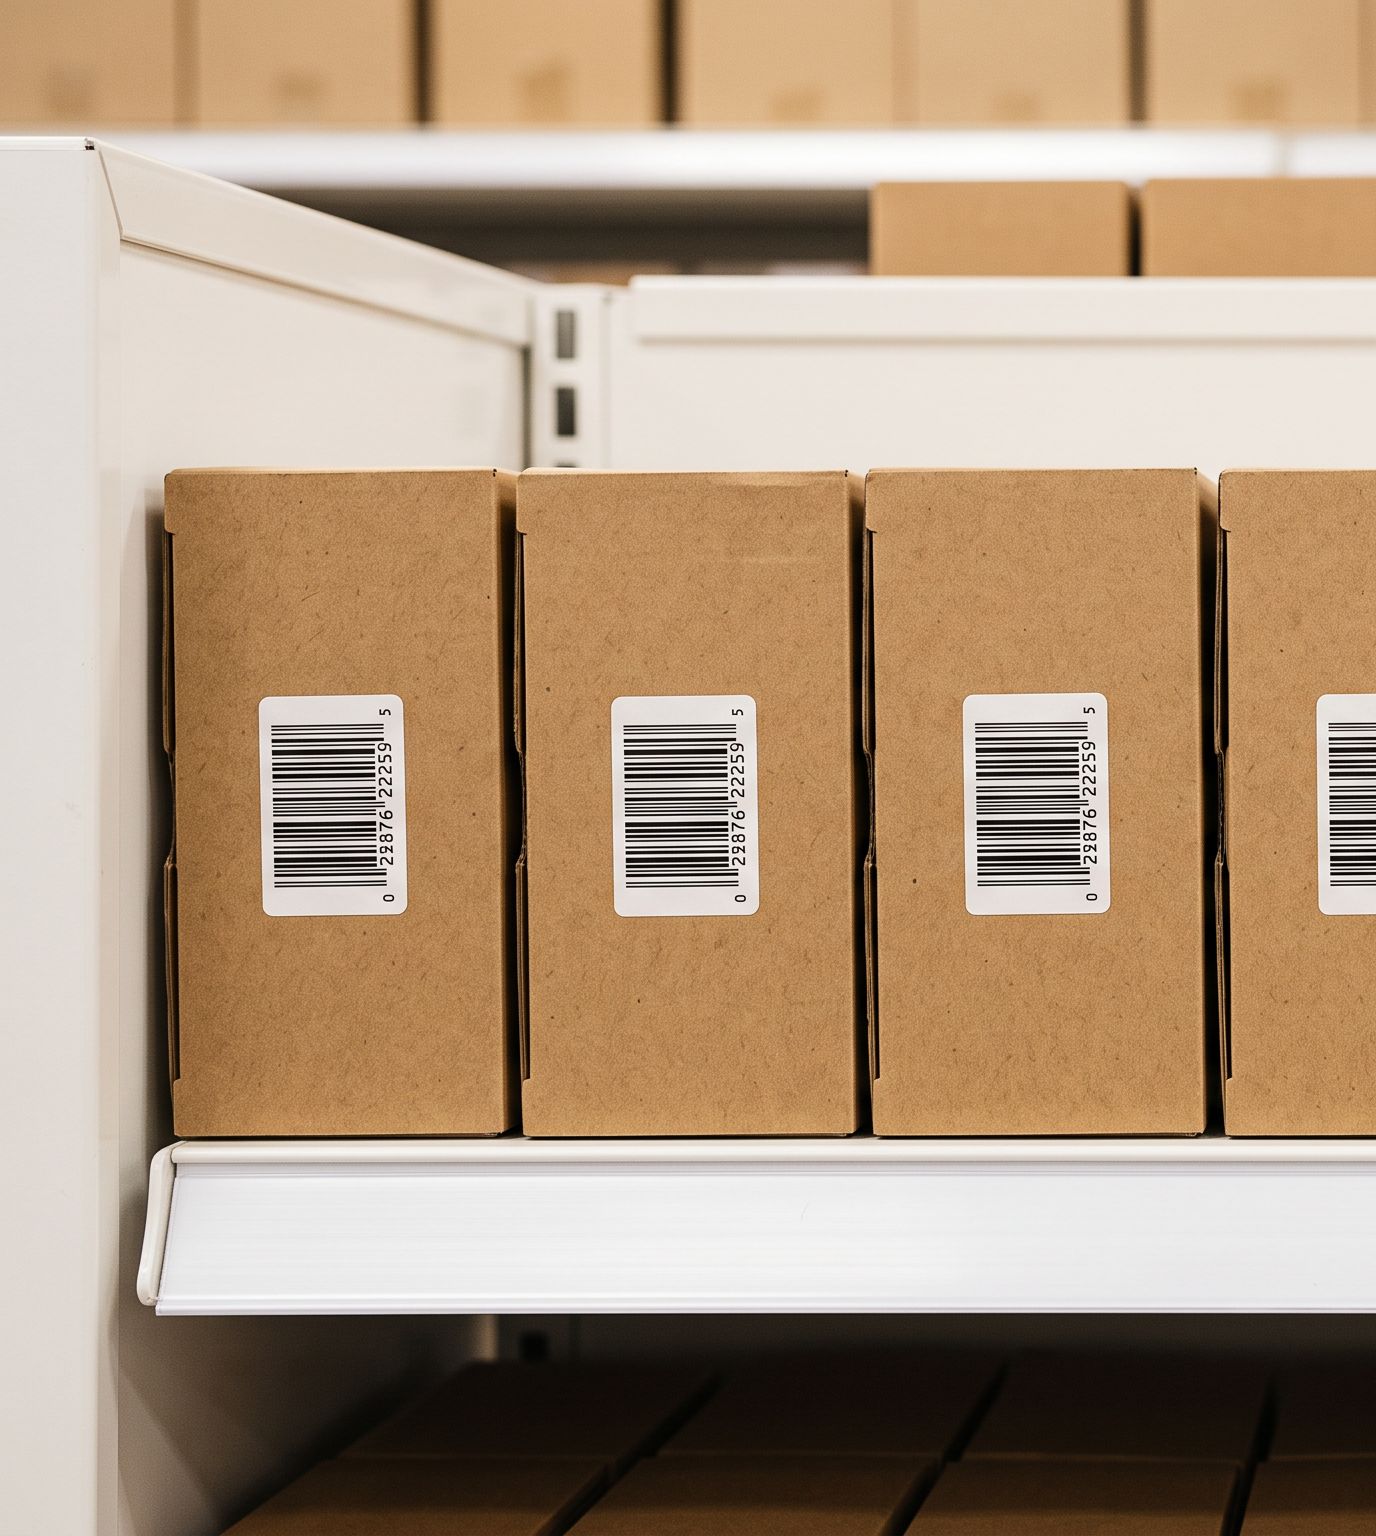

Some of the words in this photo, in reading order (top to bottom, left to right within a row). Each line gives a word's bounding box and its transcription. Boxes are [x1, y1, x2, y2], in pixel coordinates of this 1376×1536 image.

[378, 708, 392, 716] 5
[731, 708, 744, 716] 5
[377, 742, 393, 798] 22259
[729, 742, 745, 798] 22259
[1081, 741, 1097, 797] 22259
[382, 894, 395, 903] 0
[734, 894, 747, 903] 0
[1085, 893, 1098, 902] 0
